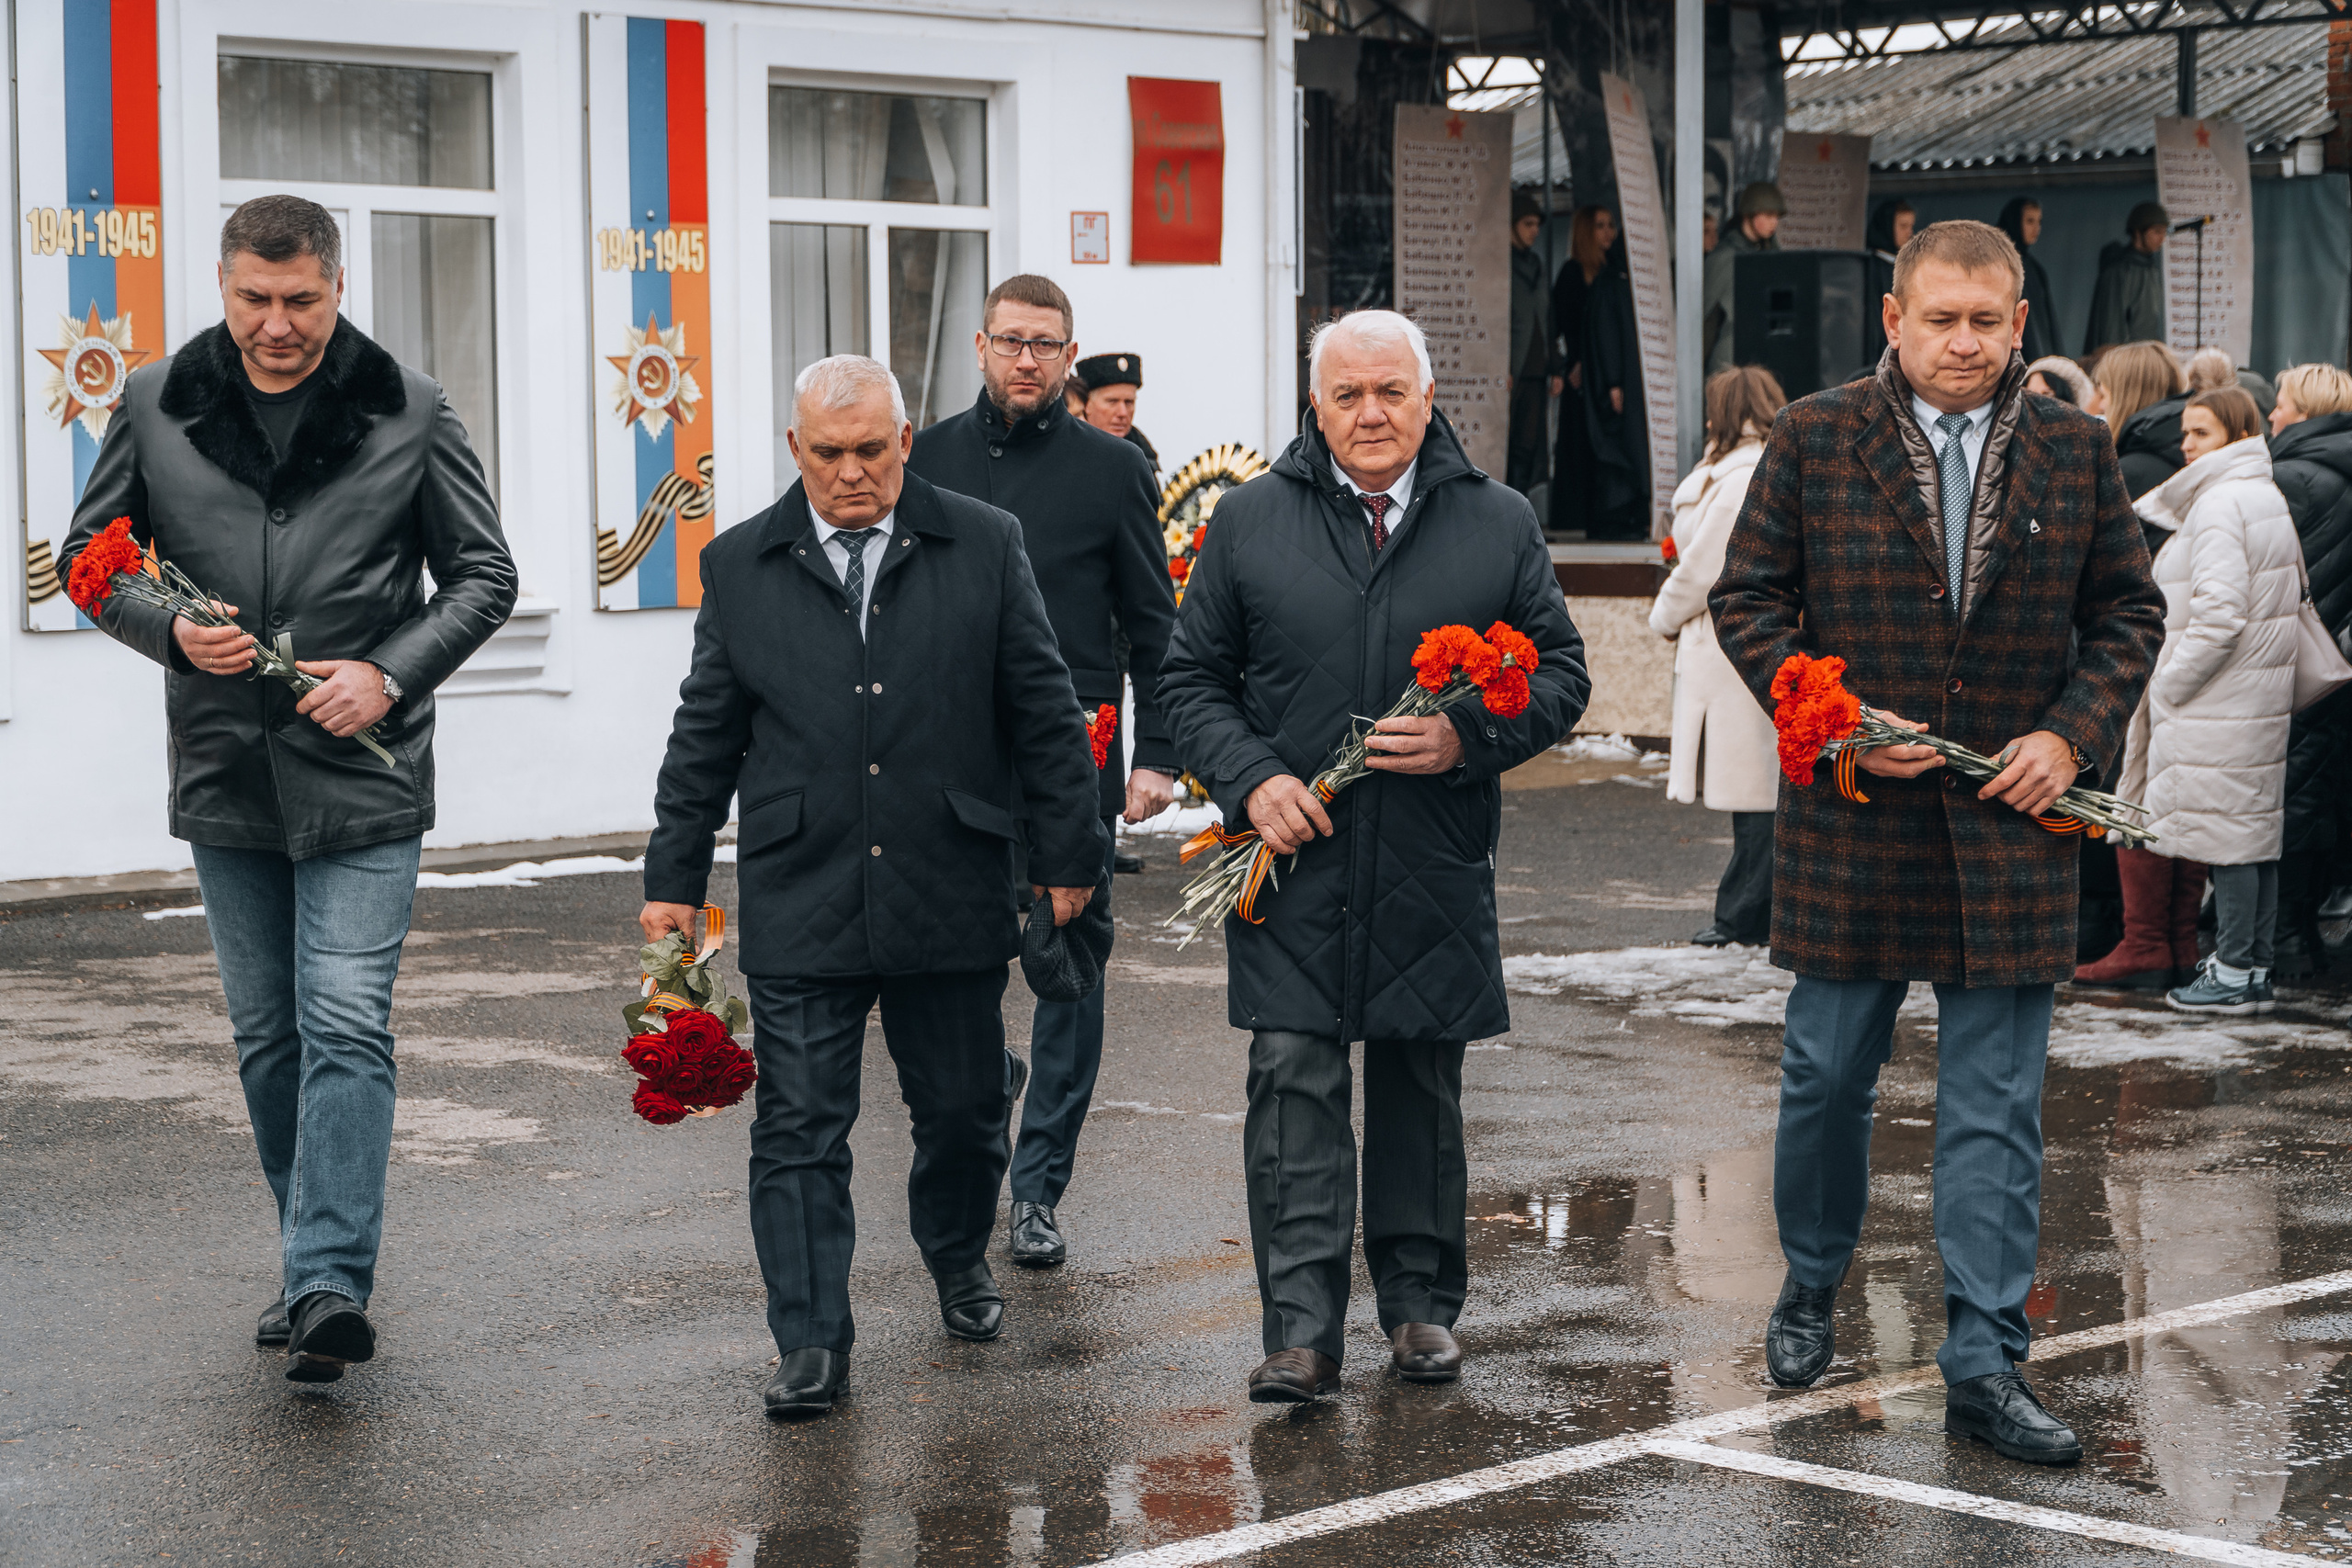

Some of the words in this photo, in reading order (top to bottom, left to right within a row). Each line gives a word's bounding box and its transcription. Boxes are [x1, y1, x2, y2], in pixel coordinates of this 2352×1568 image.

[1154, 159, 1193, 225] 61
[26, 208, 157, 259] 1941-1945
[597, 226, 706, 274] 1941-1945
